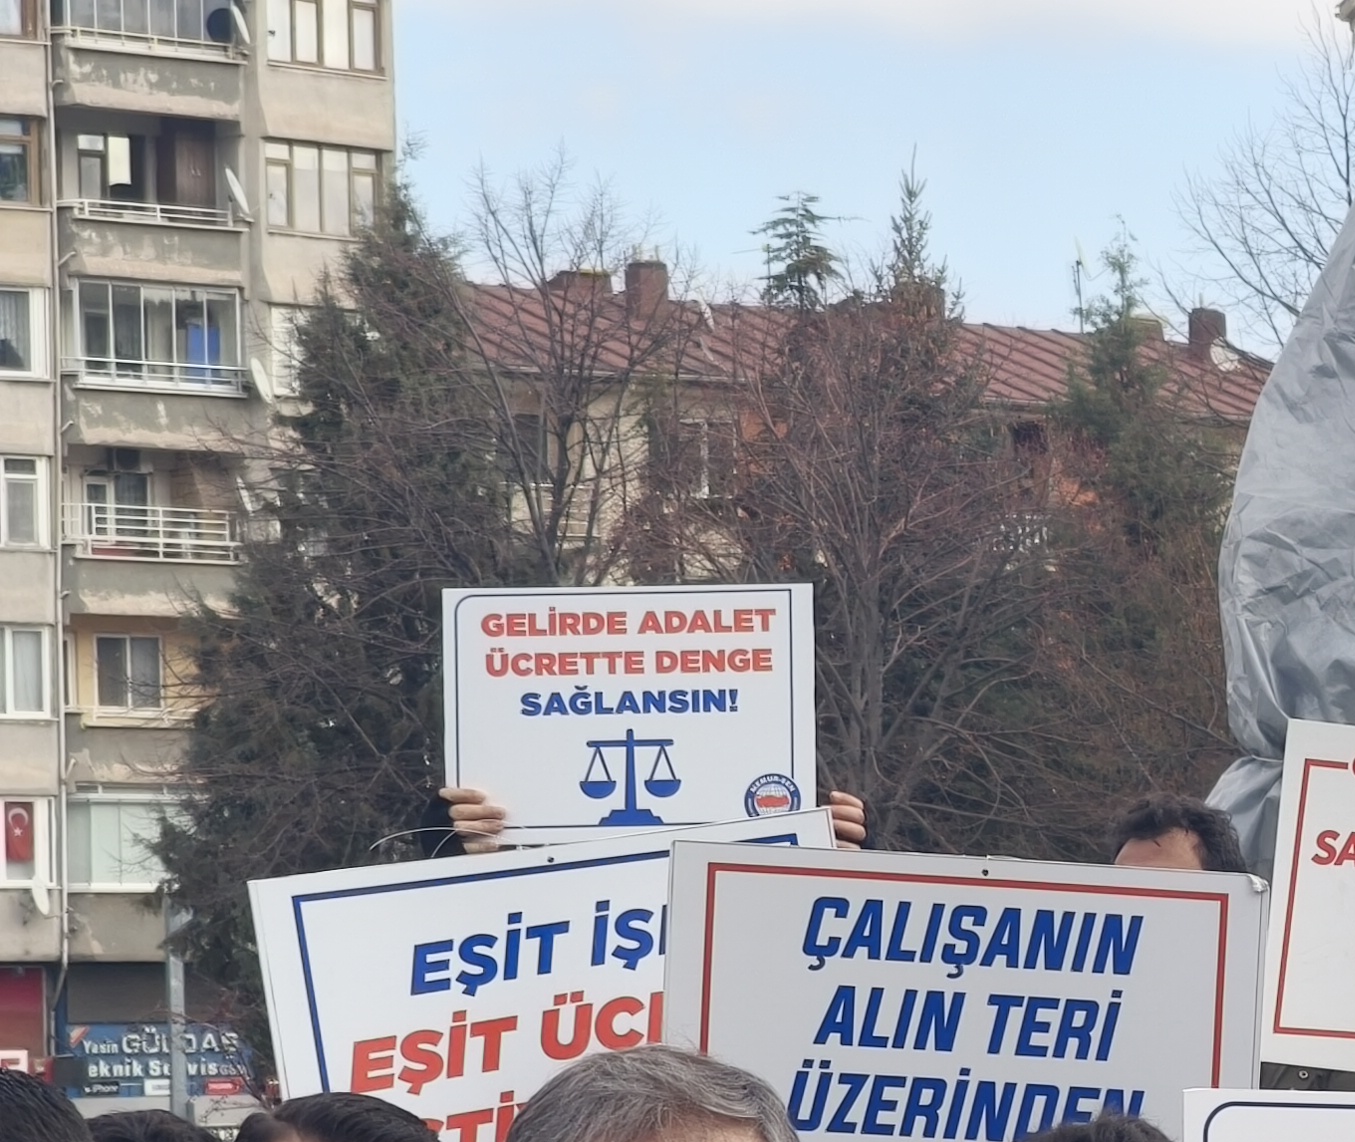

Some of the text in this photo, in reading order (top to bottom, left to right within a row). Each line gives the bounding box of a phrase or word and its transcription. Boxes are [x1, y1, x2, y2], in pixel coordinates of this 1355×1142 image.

[480, 606, 777, 637] GELİRDE ADALET
[485, 647, 773, 677] ÜCRETTE DENGE
[520, 685, 739, 717] SAĞLANSIN!
[410, 900, 668, 997] EŞİT İŞ
[801, 896, 1144, 978] ÇALIŞANIN
[350, 990, 664, 1095] EŞİT ÜC
[813, 985, 1123, 1062] ALIN TERİ
[88, 1057, 144, 1078] eknik
[149, 1057, 218, 1077] Sevis
